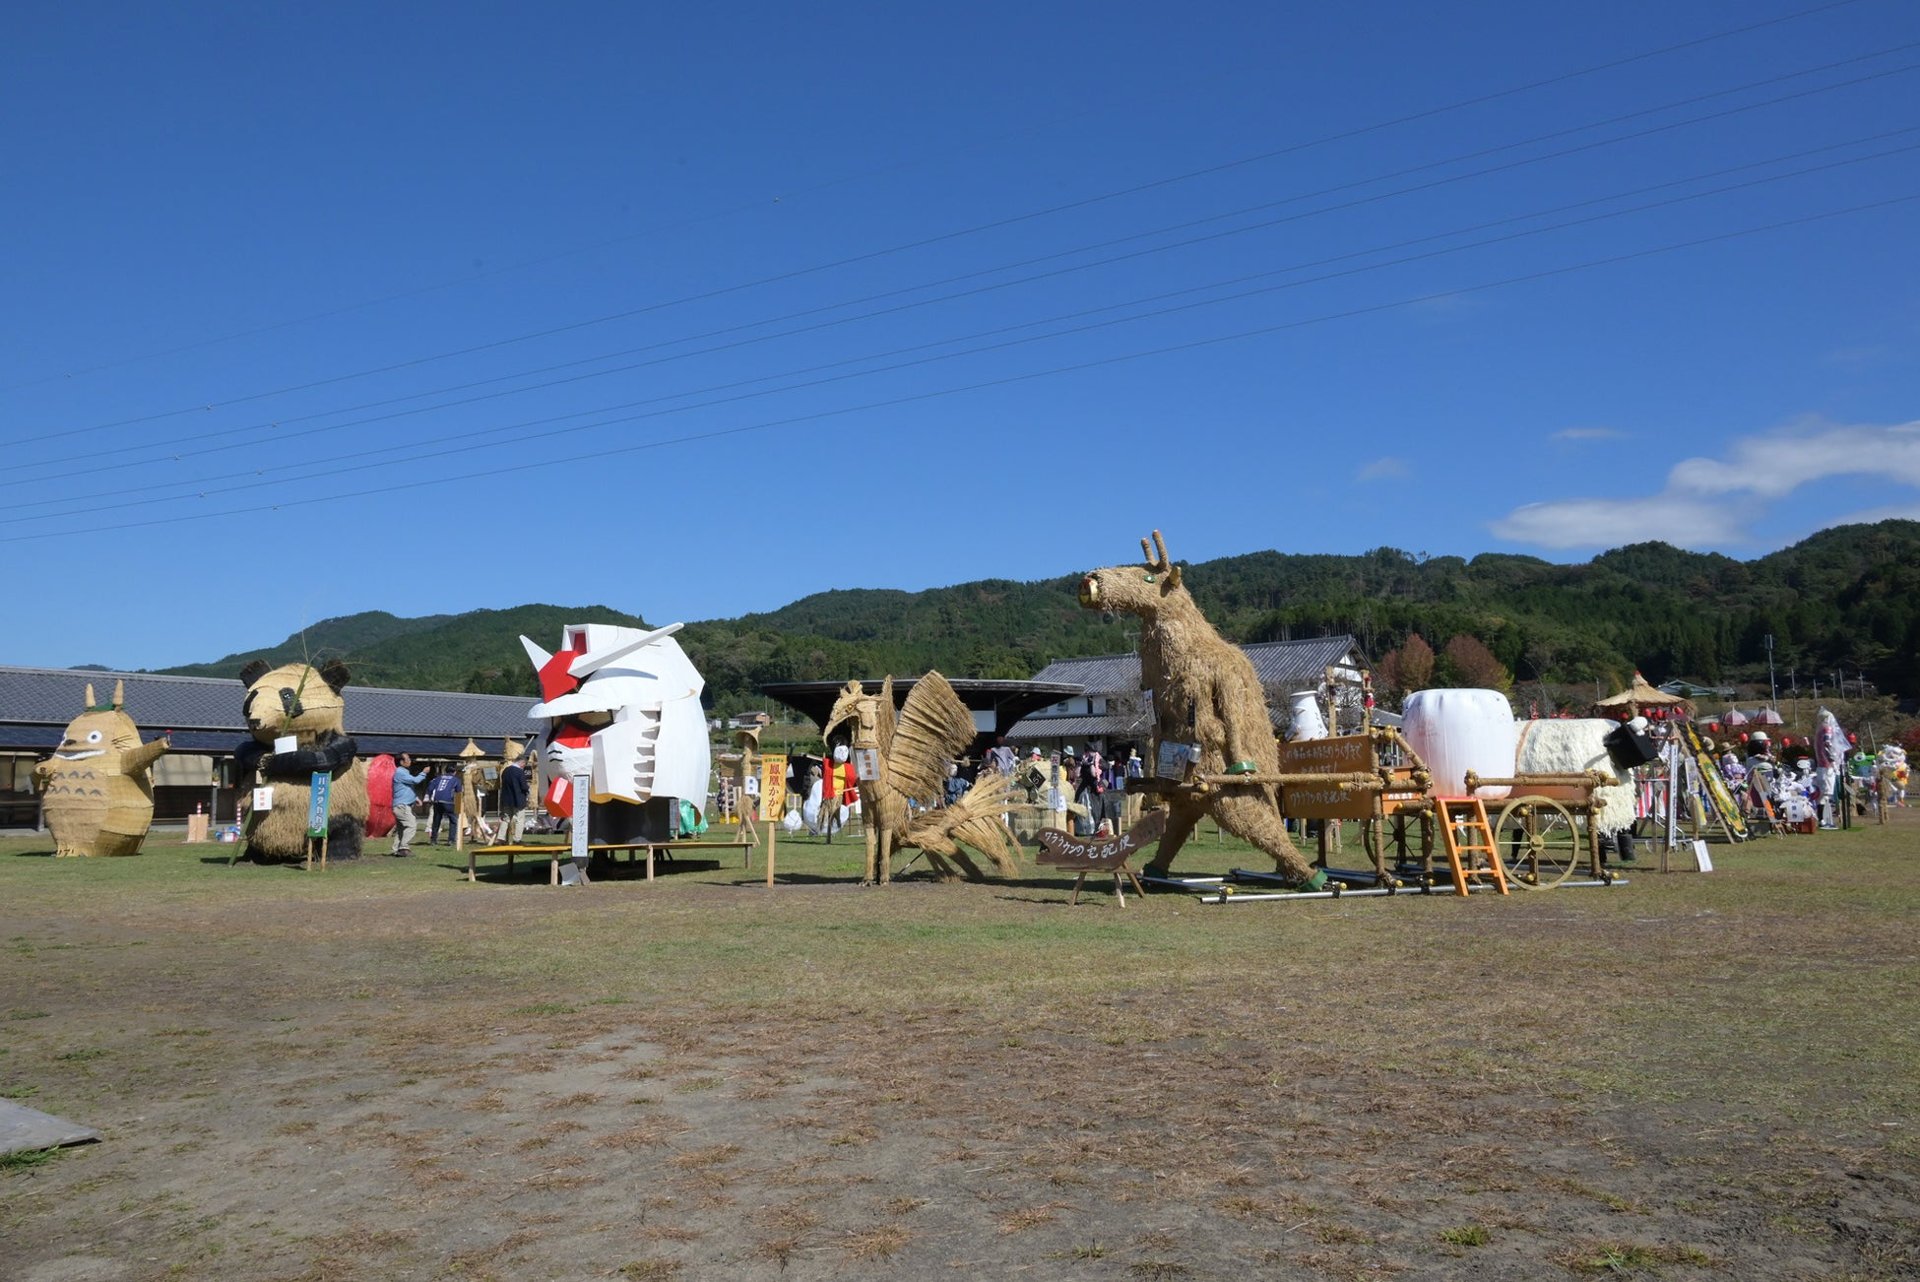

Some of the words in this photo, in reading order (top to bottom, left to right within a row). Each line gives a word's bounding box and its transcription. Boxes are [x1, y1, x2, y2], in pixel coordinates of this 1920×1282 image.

[768, 763, 780, 817] 鳳凰かかし
